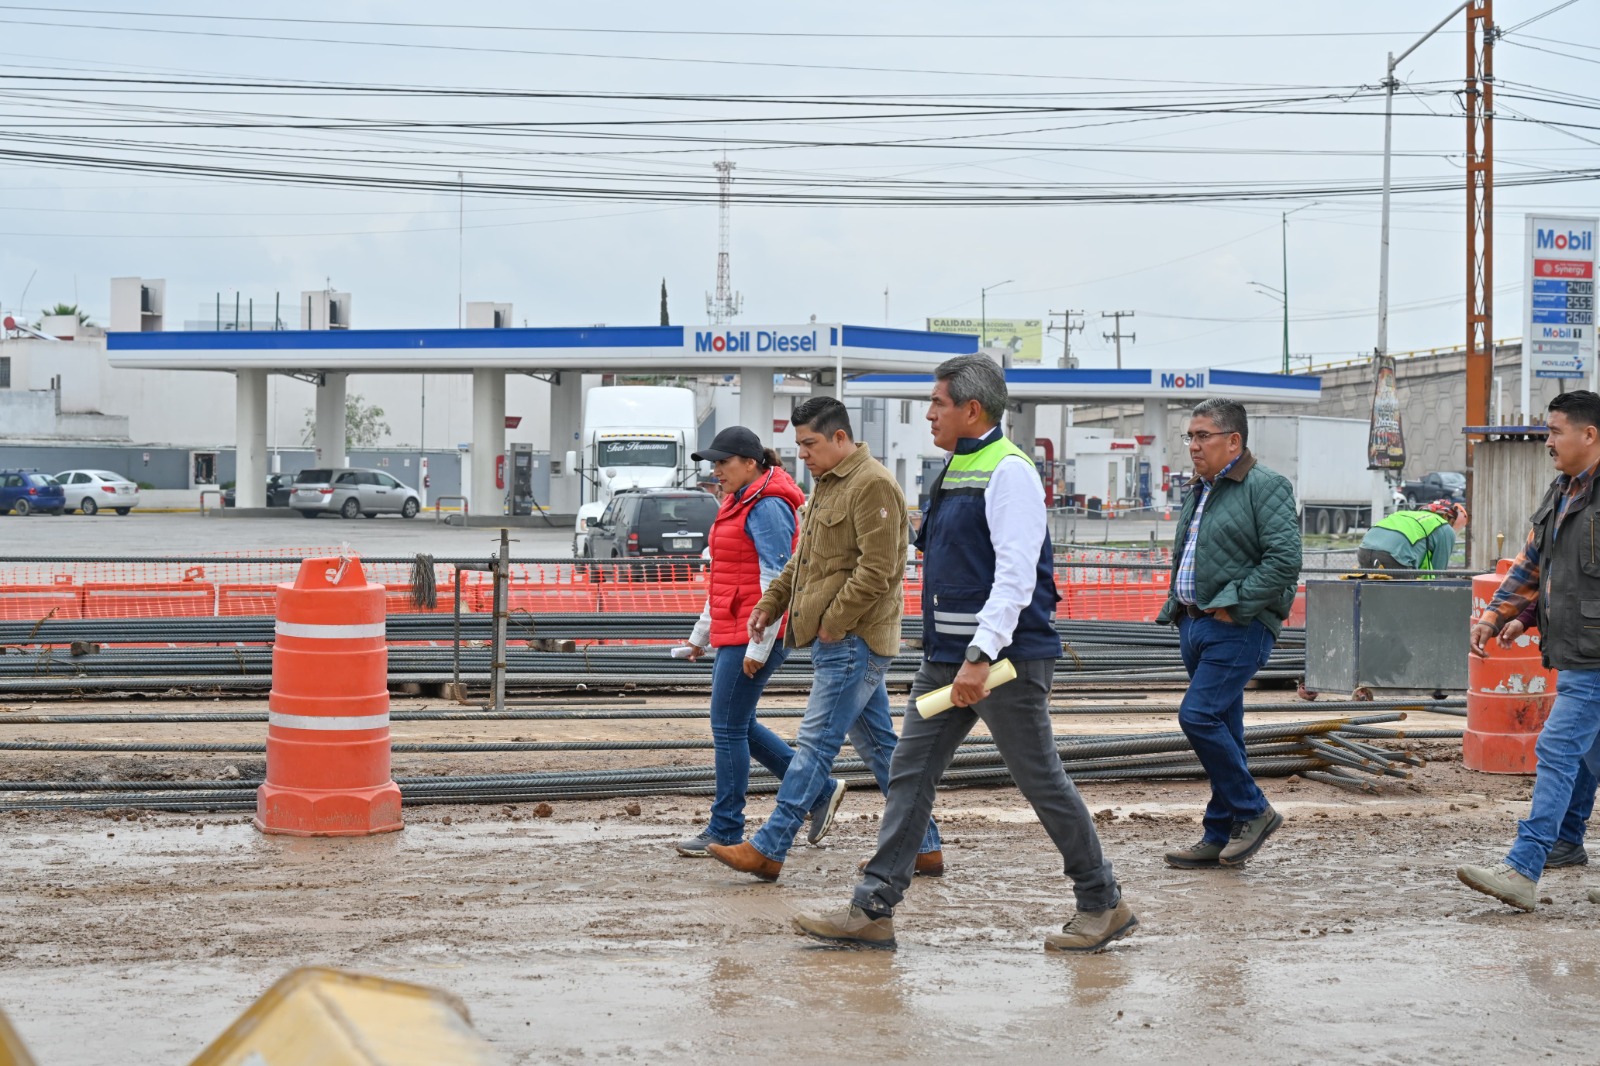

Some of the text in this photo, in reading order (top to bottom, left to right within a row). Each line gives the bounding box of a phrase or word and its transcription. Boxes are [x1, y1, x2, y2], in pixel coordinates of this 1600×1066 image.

[1537, 229, 1591, 250] Mobil
[1554, 264, 1585, 276] Synergy
[1543, 328, 1582, 339] Mobil 1
[695, 331, 816, 352] Mobil Diesel
[1161, 373, 1204, 388] Mobil
[606, 442, 624, 452] Tres
